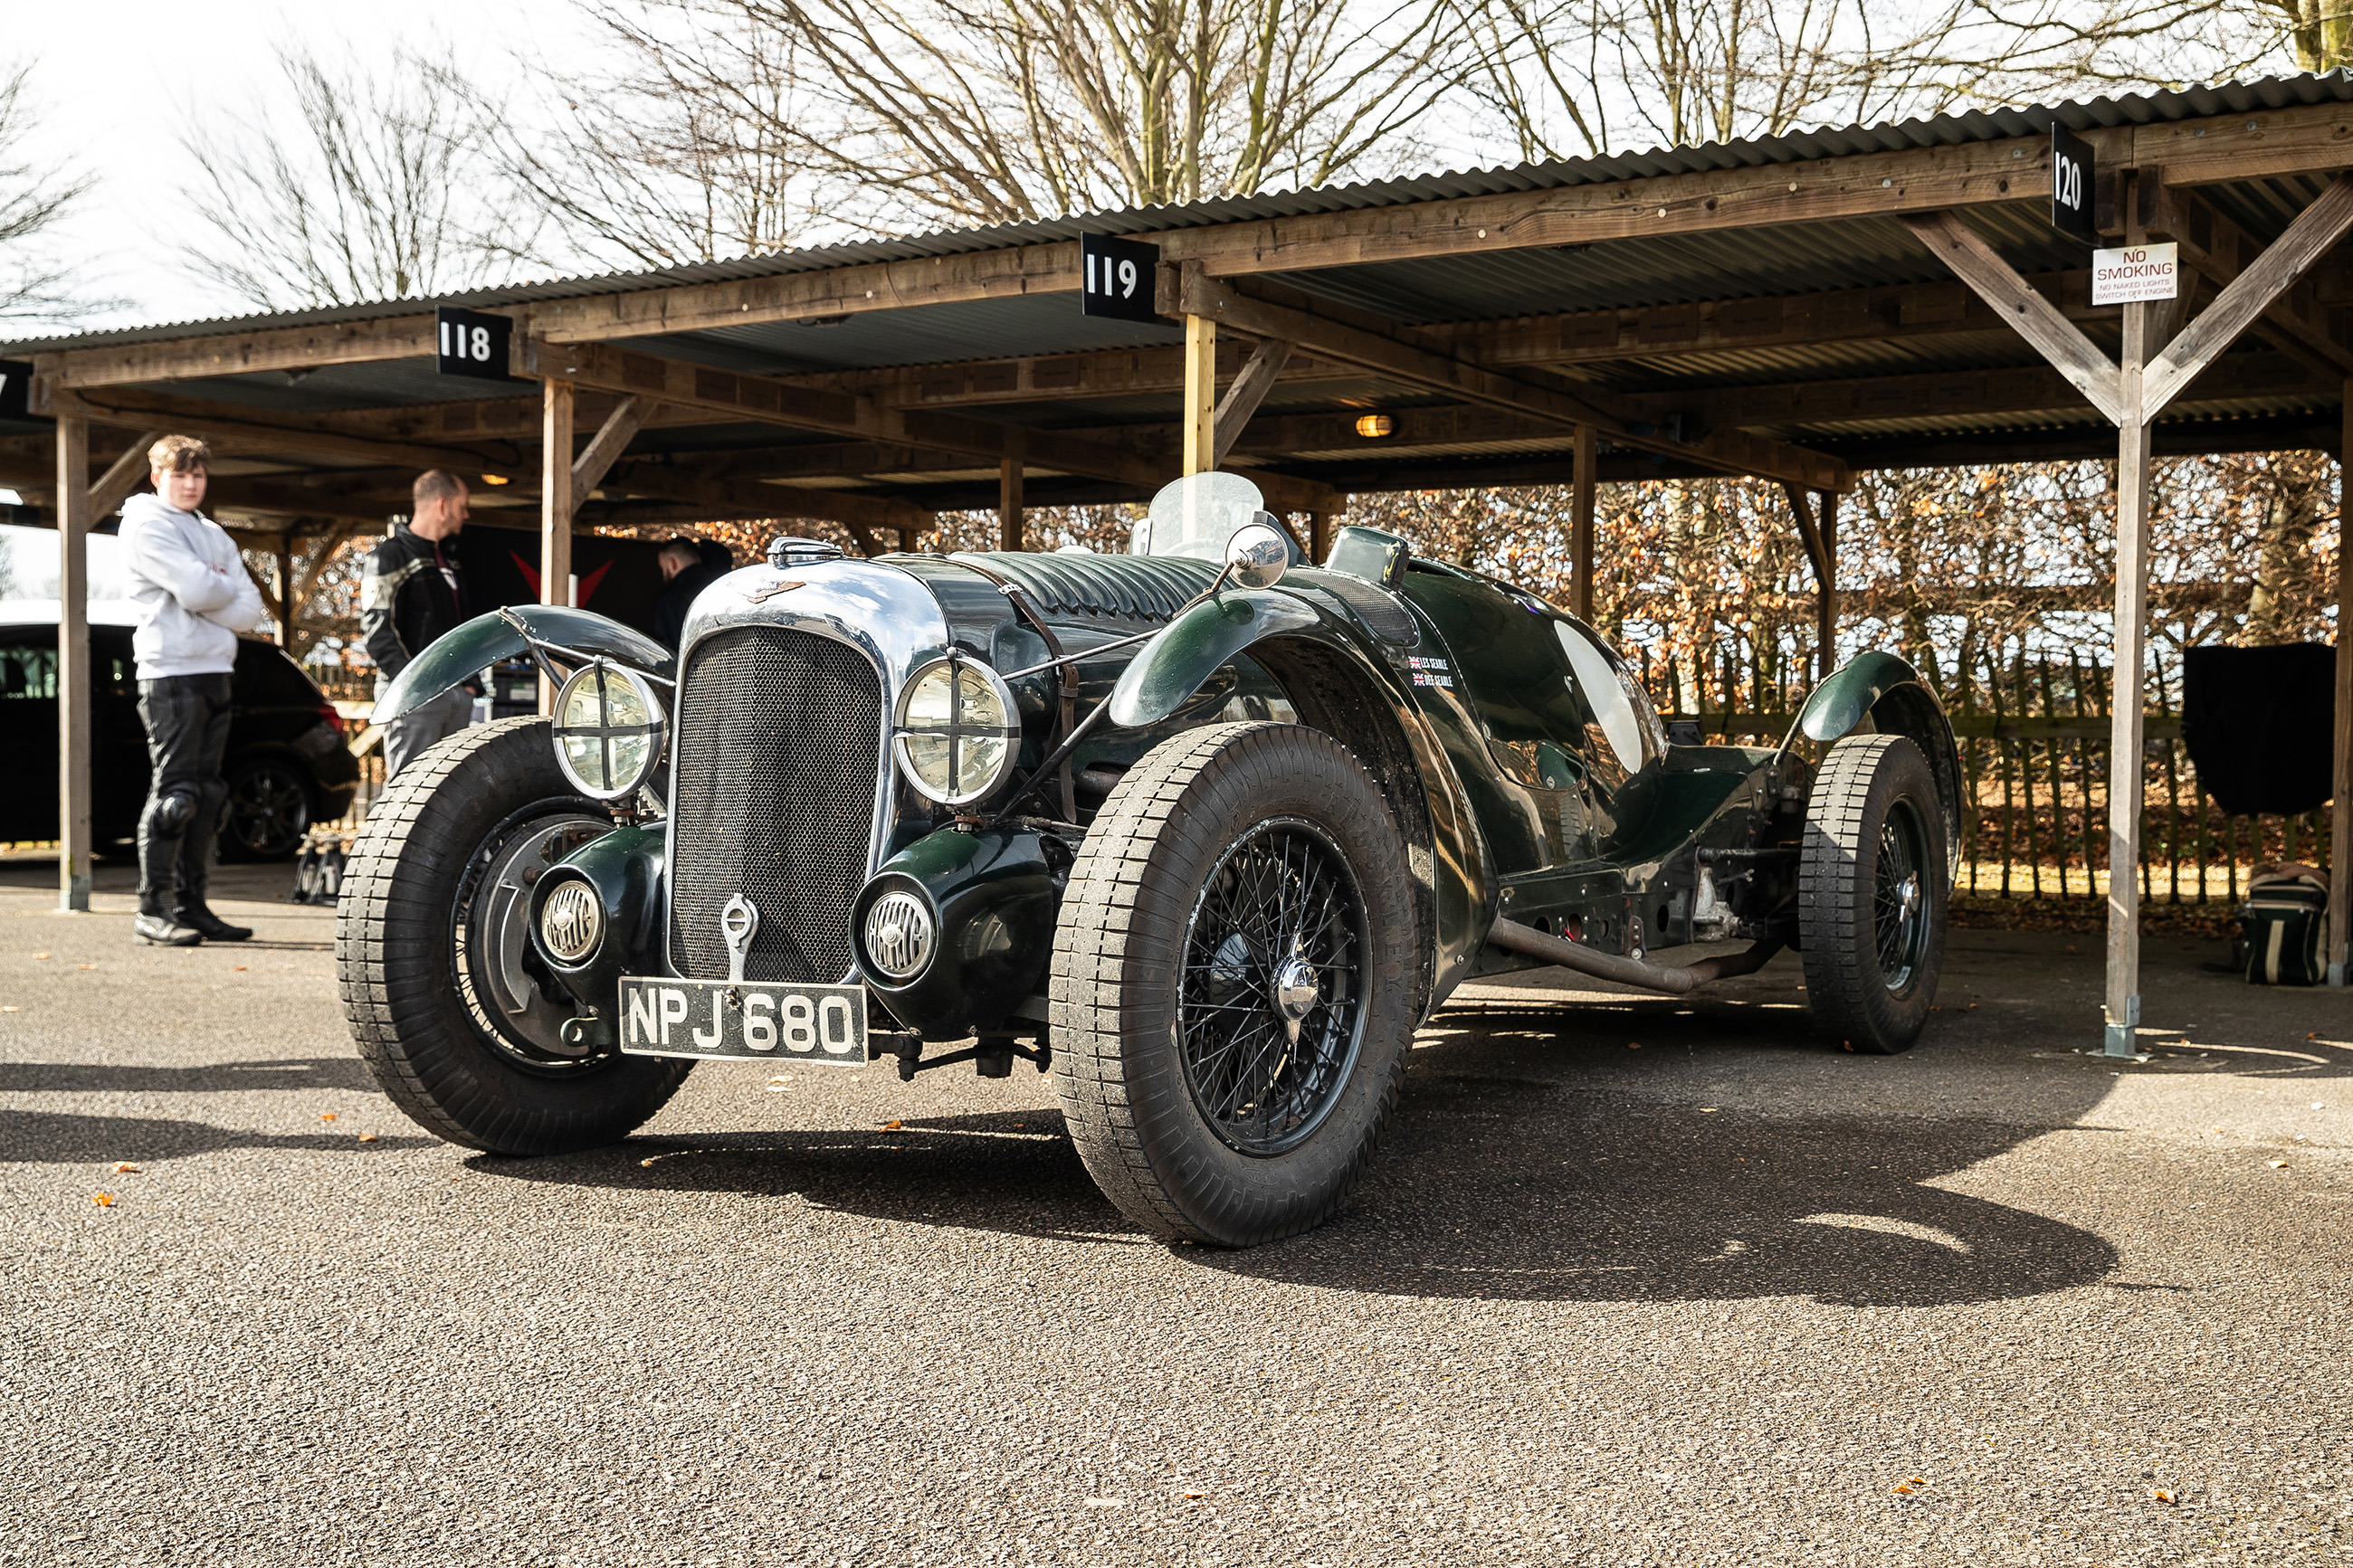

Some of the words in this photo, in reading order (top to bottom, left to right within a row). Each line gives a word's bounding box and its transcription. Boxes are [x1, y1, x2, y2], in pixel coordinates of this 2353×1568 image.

[2054, 151, 2082, 211] 120
[2123, 250, 2147, 263] NO
[1087, 252, 1137, 299] 119
[2097, 262, 2173, 280] SMOKING
[2113, 280, 2140, 290] NAKED
[2142, 278, 2170, 287] LIGHTS
[2095, 290, 2126, 300] SWITCH
[2128, 290, 2141, 298] OFF
[2144, 287, 2174, 296] ENGINE
[439, 320, 491, 361] 118
[1420, 657, 1430, 669] LES
[1429, 658, 1448, 670] SEARLE
[1424, 674, 1434, 686] DEE
[1434, 675, 1453, 687] SEARLE
[627, 986, 723, 1049] NPJ
[743, 993, 853, 1054] 680
